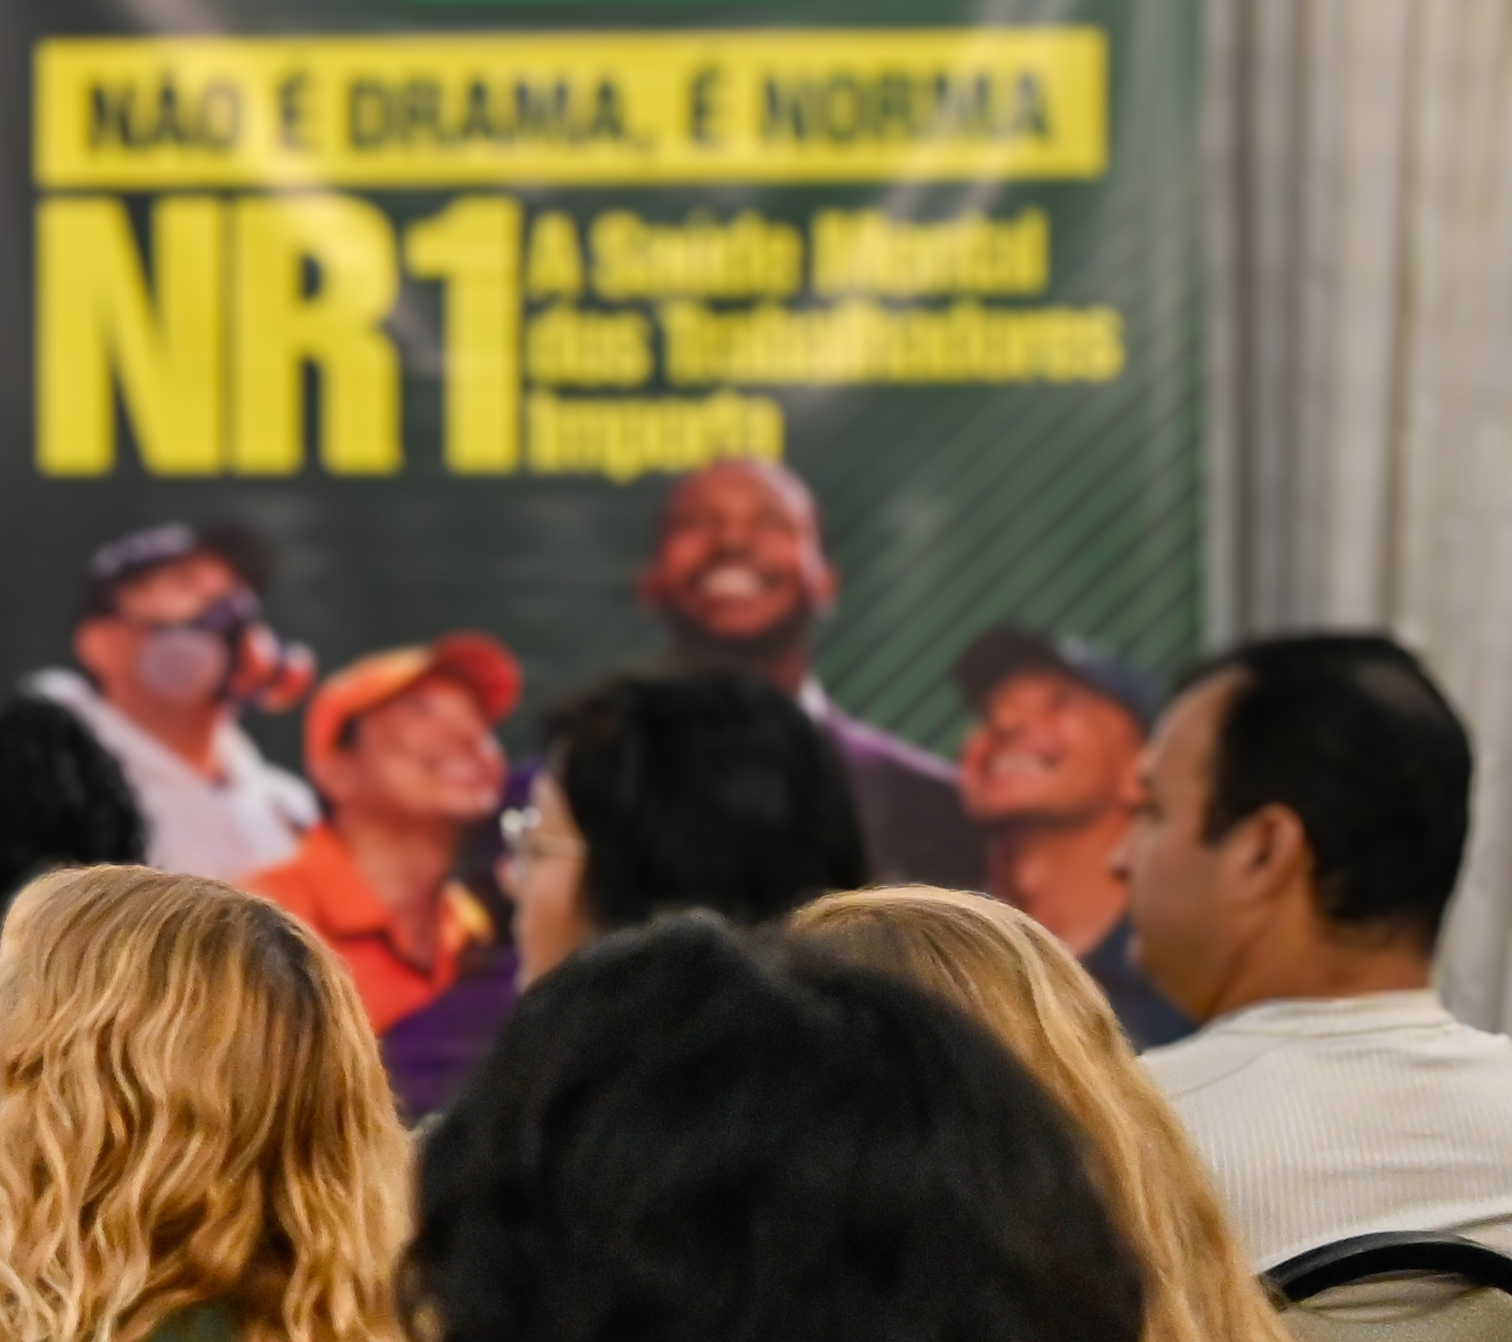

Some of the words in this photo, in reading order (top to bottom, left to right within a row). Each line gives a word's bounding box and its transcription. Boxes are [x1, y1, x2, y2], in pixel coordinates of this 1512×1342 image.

[86, 65, 244, 150] NÃO
[278, 63, 317, 150] É
[347, 75, 655, 153] DRAMA,
[689, 63, 726, 150] É
[762, 70, 1053, 145] NORMA
[527, 211, 584, 300] A
[36, 196, 524, 474] NR1
